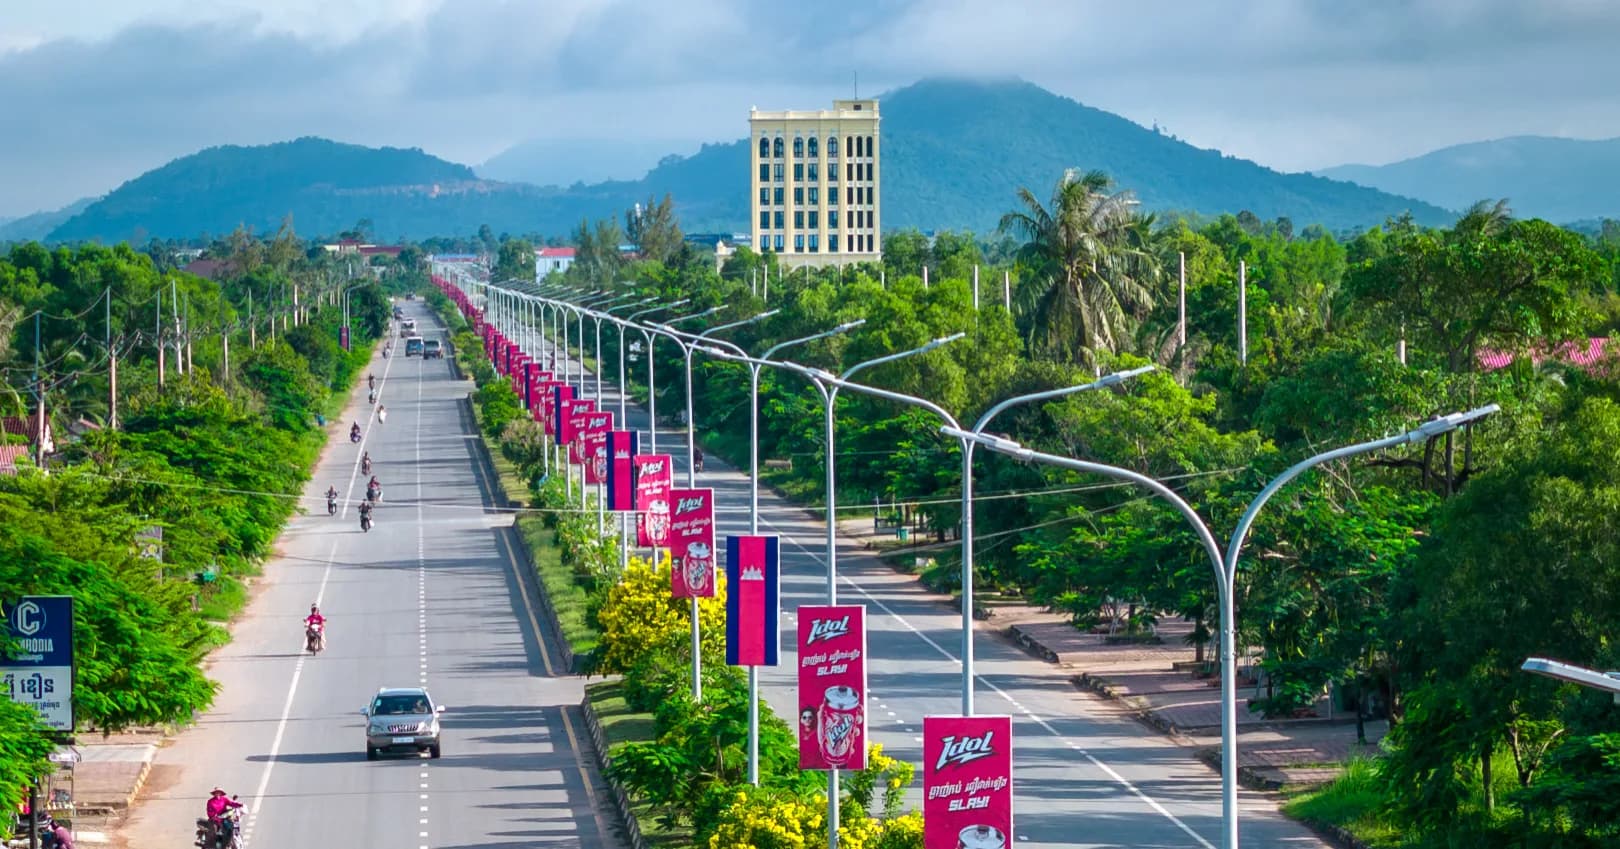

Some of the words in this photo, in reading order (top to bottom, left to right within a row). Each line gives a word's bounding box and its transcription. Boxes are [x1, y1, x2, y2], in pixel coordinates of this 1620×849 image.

[807, 616, 850, 645] Idol
[935, 731, 994, 771] Idol
[947, 796, 991, 812] SLAY!
